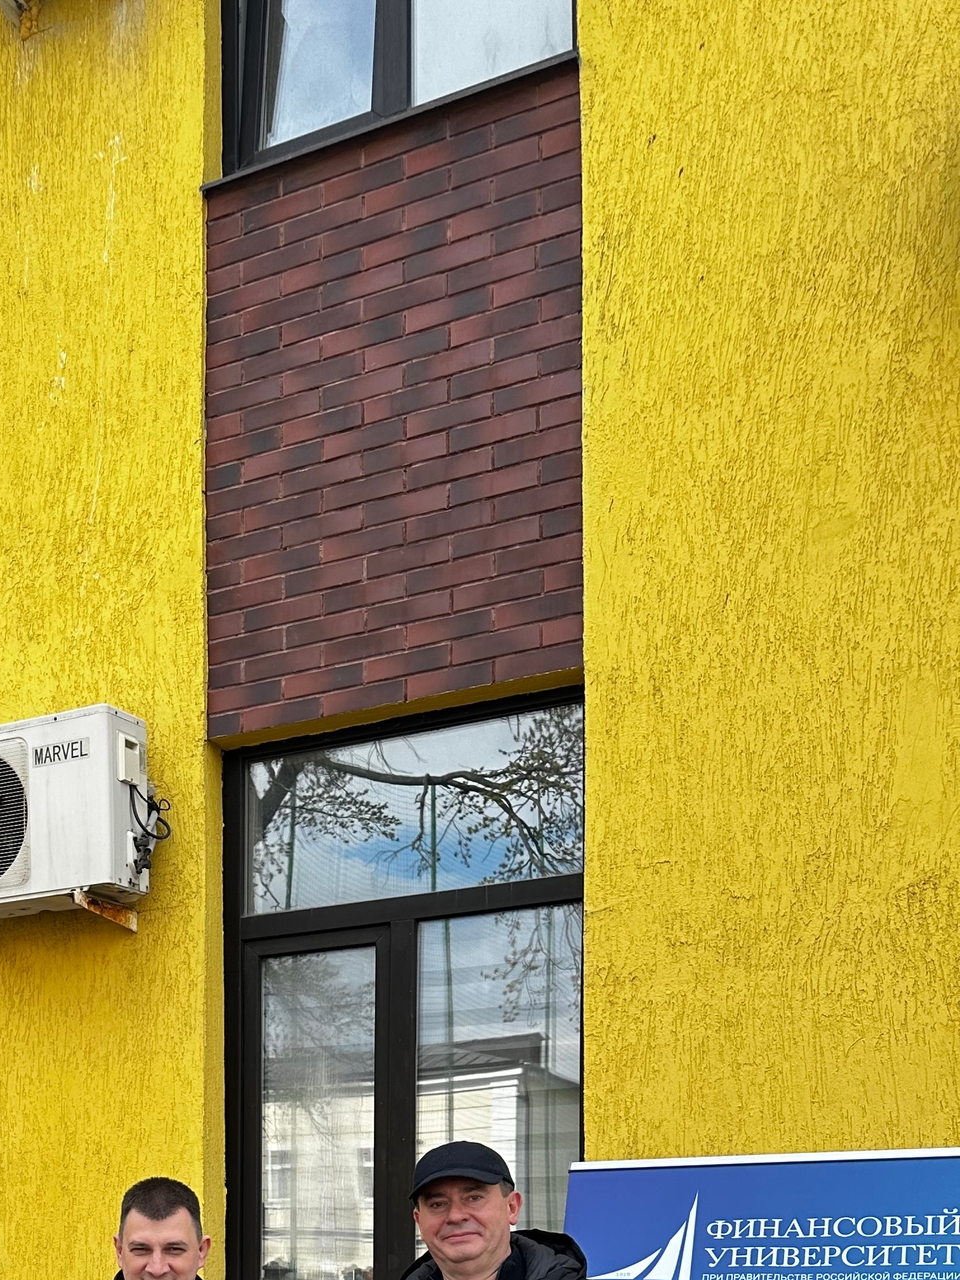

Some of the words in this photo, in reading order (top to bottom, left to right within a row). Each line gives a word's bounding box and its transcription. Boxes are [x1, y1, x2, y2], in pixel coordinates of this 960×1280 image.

[35, 740, 88, 766] MARVEL
[706, 1207, 960, 1239] ФИНАНСОВЫЙ
[704, 1244, 960, 1268] УНИВЕРСИТЕТ
[702, 1273, 724, 1280] ПРИ
[816, 1271, 890, 1280] РОССИЙСКОЙ
[893, 1271, 960, 1280] ФЕДЕРАЦИИ
